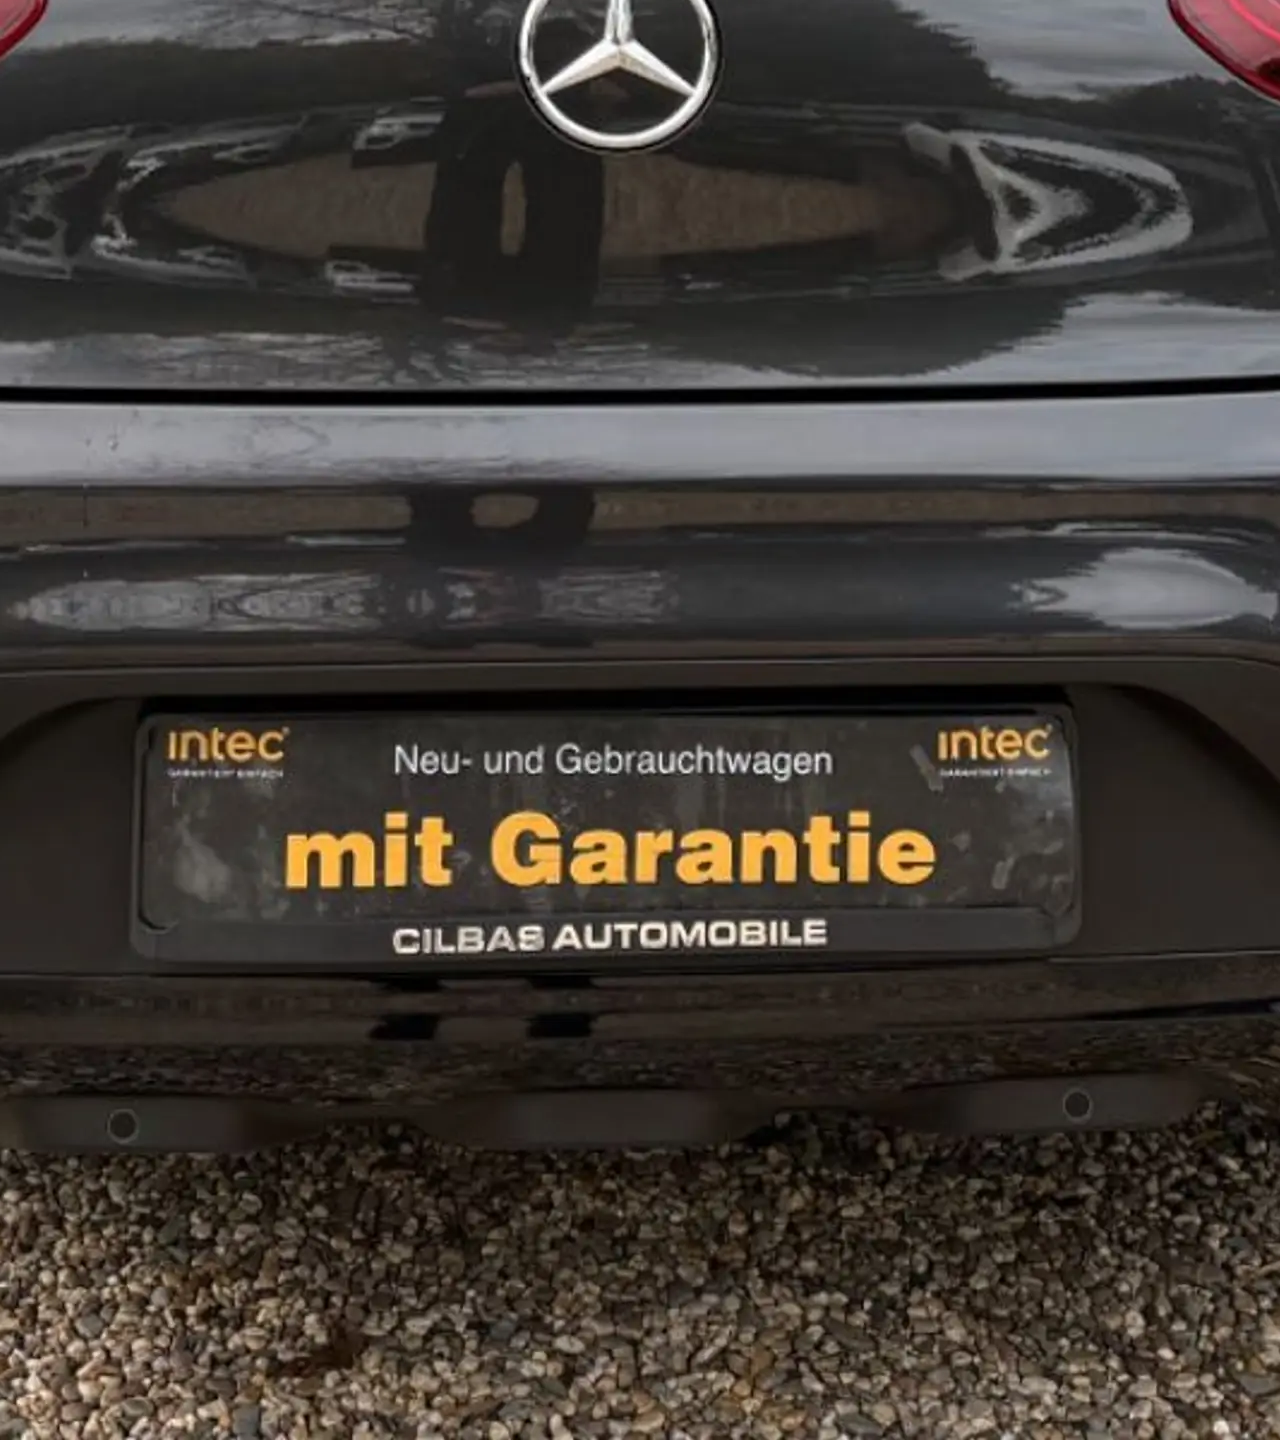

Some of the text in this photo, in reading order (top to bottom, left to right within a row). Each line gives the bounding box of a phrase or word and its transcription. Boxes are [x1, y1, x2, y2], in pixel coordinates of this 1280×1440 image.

[167, 725, 285, 763] intec
[937, 724, 1051, 761] intec
[394, 742, 833, 783] Neu- und Gebrauchtwagen
[285, 809, 936, 890] mit Garantie
[392, 919, 828, 955] CILBAS AUTOMOBILE
